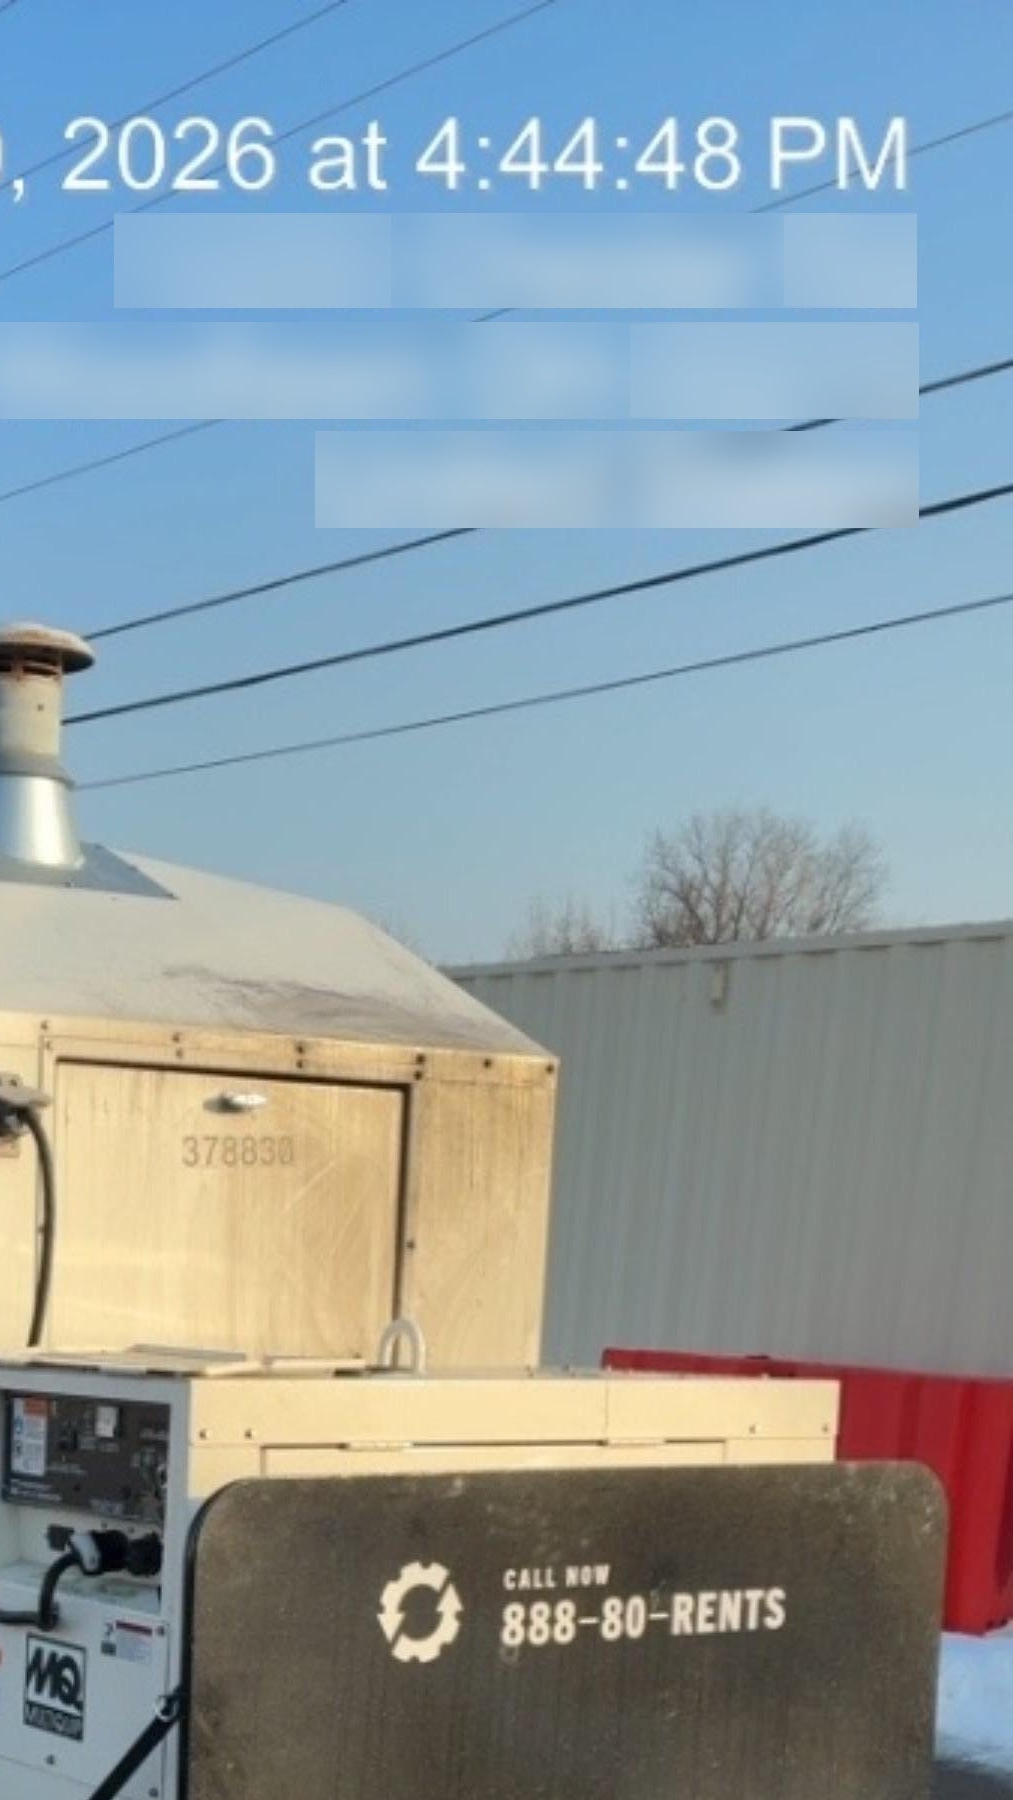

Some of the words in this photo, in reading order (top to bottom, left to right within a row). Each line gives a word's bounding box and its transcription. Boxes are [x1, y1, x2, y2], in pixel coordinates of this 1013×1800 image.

[182, 1135, 294, 1168] 378830
[502, 1567, 556, 1590] CALL
[565, 1564, 610, 1587] NOW
[500, 1586, 787, 1647] 888-80-RENTS
[26, 1645, 84, 1713] MQ
